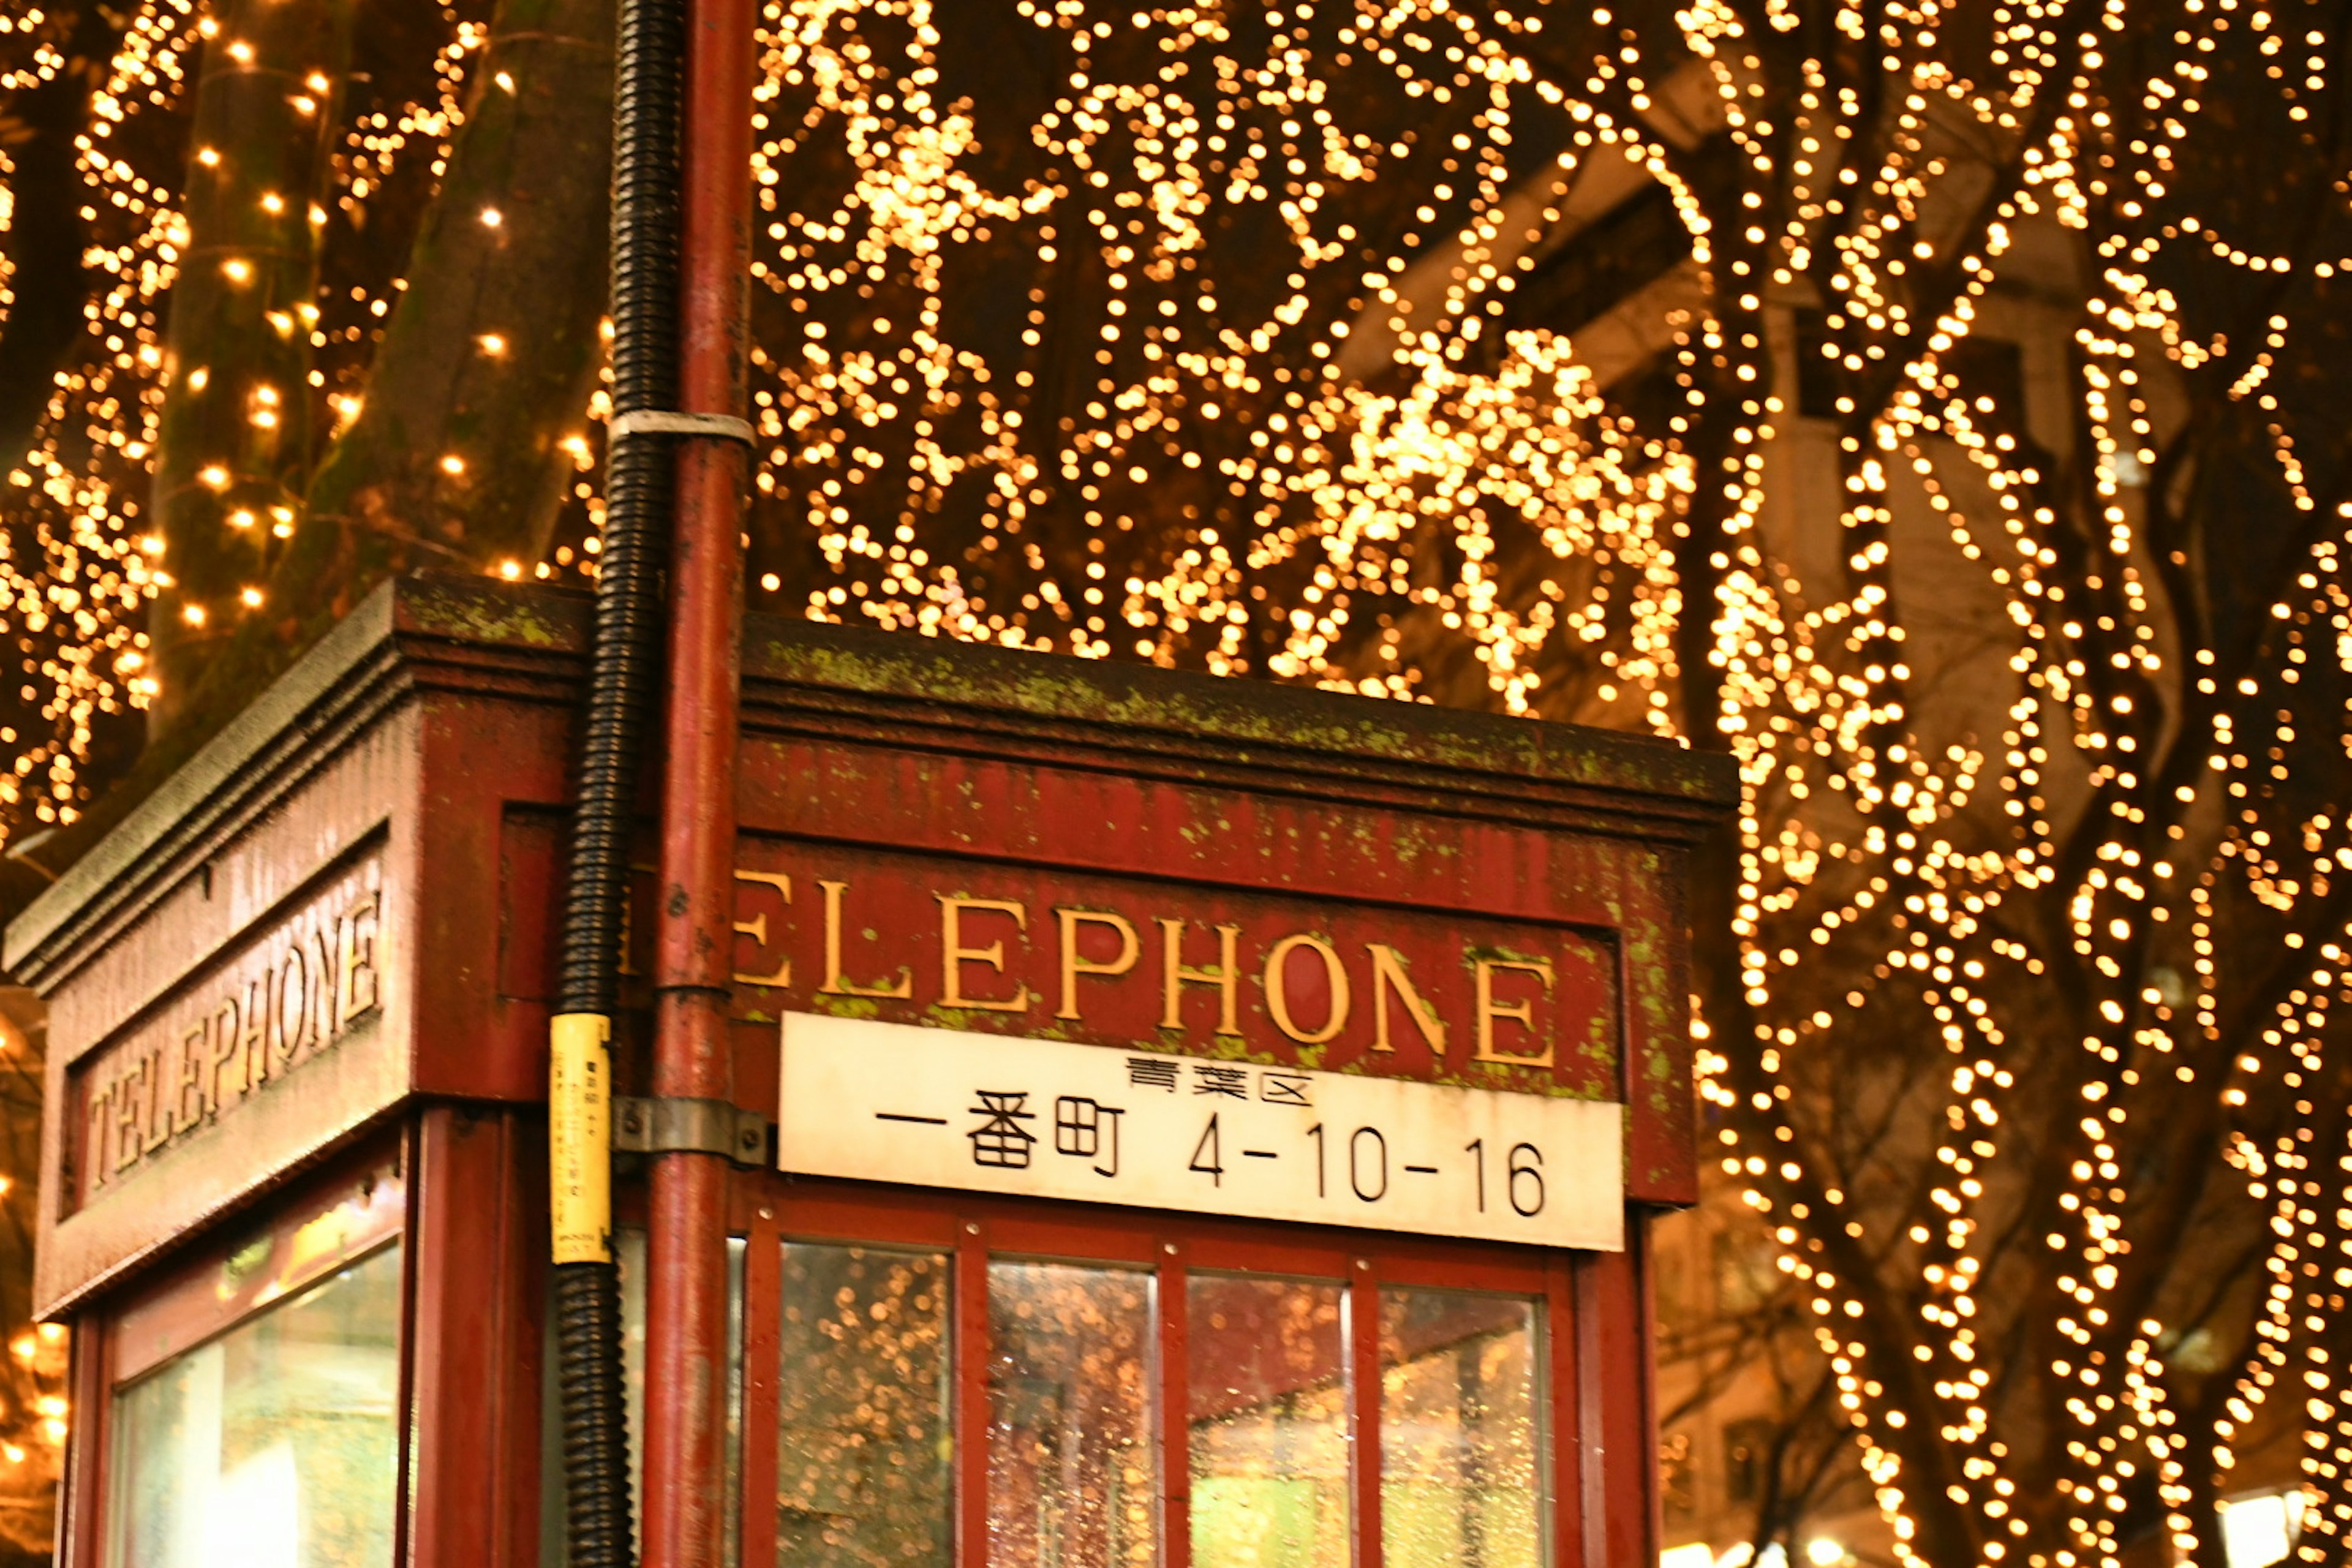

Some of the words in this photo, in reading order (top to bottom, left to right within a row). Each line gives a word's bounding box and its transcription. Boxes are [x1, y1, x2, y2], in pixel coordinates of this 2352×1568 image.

[89, 897, 381, 1189] TELEPHONE
[1126, 1057, 1313, 1107] 青葉区
[875, 1089, 1125, 1177] 一番町
[1189, 1112, 1545, 1217] 4-10-16
